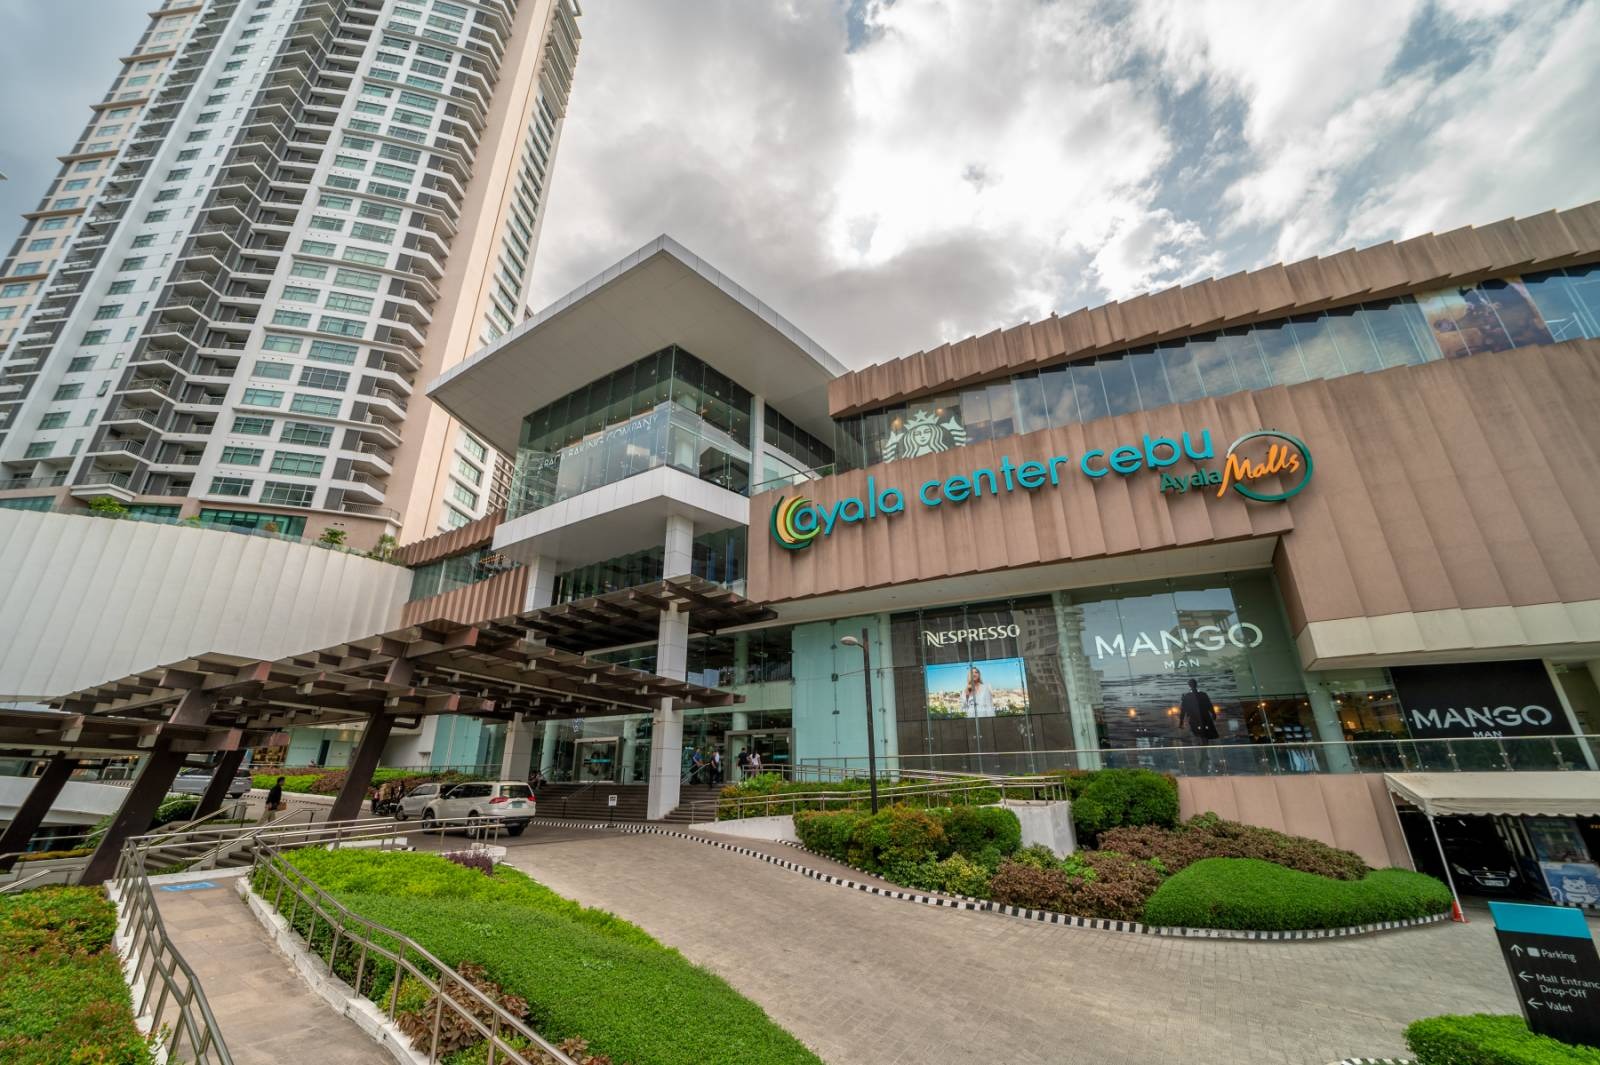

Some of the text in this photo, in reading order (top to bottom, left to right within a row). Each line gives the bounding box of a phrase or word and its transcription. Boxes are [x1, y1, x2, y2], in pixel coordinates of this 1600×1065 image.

[606, 414, 659, 440] COMPANY
[1159, 443, 1301, 498] Ayala Malls
[793, 427, 1215, 537] ayala center cebu
[921, 624, 1021, 648] NESPRESSO
[1094, 621, 1264, 661] MANGO
[1163, 658, 1201, 670] MAN
[1411, 704, 1553, 730] MANGO
[1472, 730, 1504, 739] MAN
[1541, 948, 1577, 963] Parking
[1535, 972, 1600, 990] Mall Entranc
[1539, 985, 1587, 998] Drop-Off
[1545, 1001, 1573, 1013] Valet
